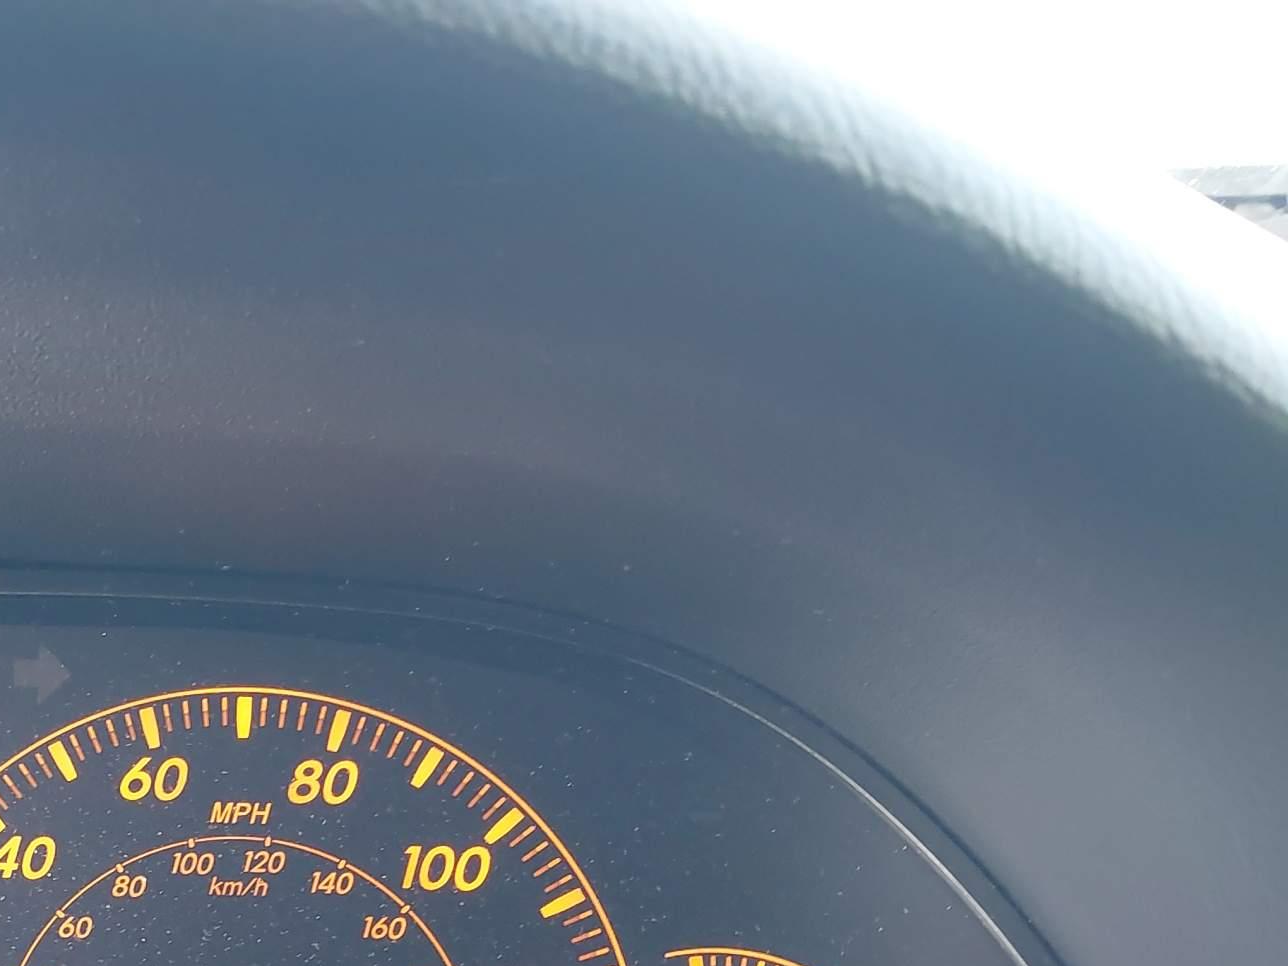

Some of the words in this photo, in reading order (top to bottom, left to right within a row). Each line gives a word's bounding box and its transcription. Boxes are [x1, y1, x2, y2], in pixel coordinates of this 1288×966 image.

[119, 757, 189, 802] 60
[287, 759, 359, 805] 80
[210, 801, 272, 825] MPH
[171, 852, 215, 875] 100
[243, 850, 286, 874] 120
[401, 845, 492, 892] 100
[111, 874, 147, 898] 80
[208, 876, 269, 897] km/h
[311, 871, 354, 895] 140
[57, 916, 93, 940] 60
[362, 916, 407, 941] 160
